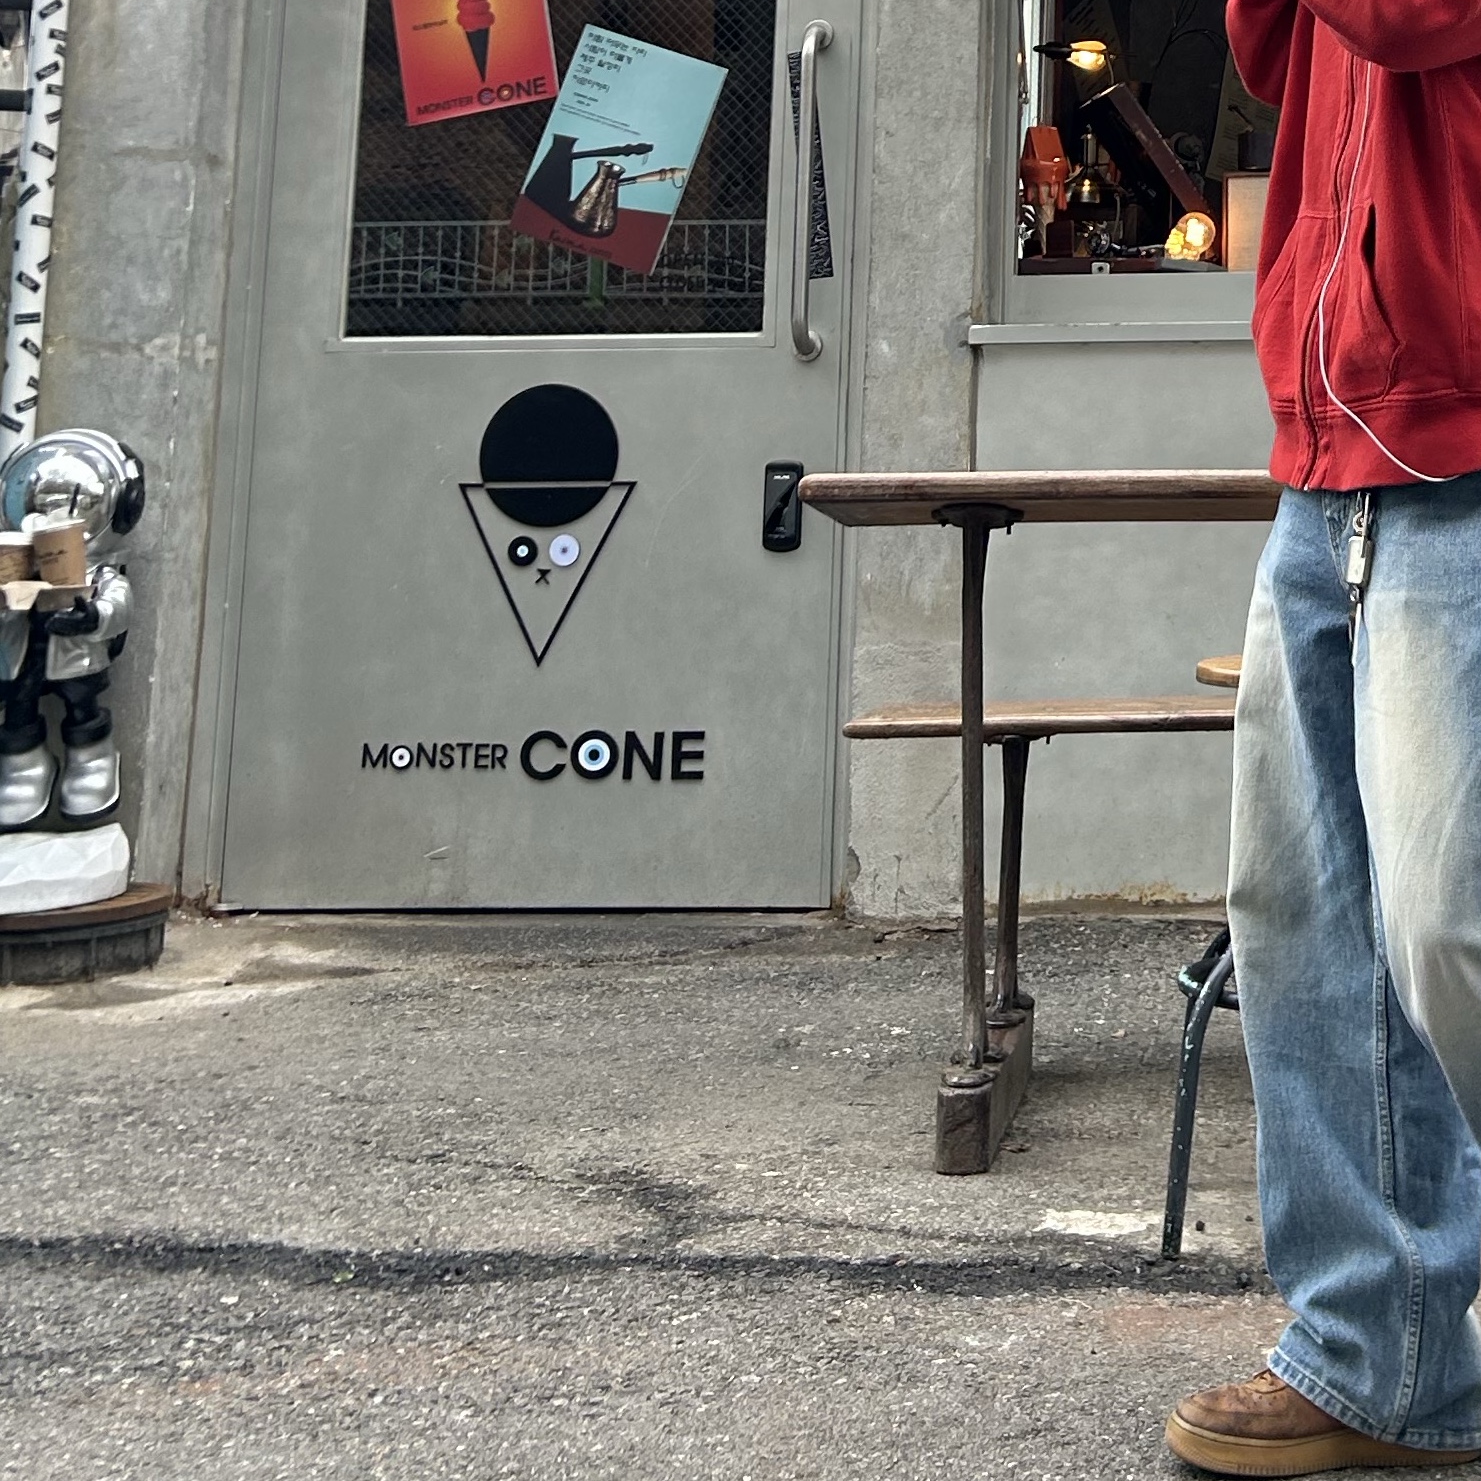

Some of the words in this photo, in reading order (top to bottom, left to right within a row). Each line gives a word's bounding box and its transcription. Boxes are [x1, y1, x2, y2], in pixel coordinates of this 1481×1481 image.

[416, 95, 473, 116] MONSTER
[477, 76, 548, 107] CONE
[361, 742, 508, 772] MONSTER
[520, 729, 706, 781] CONE
